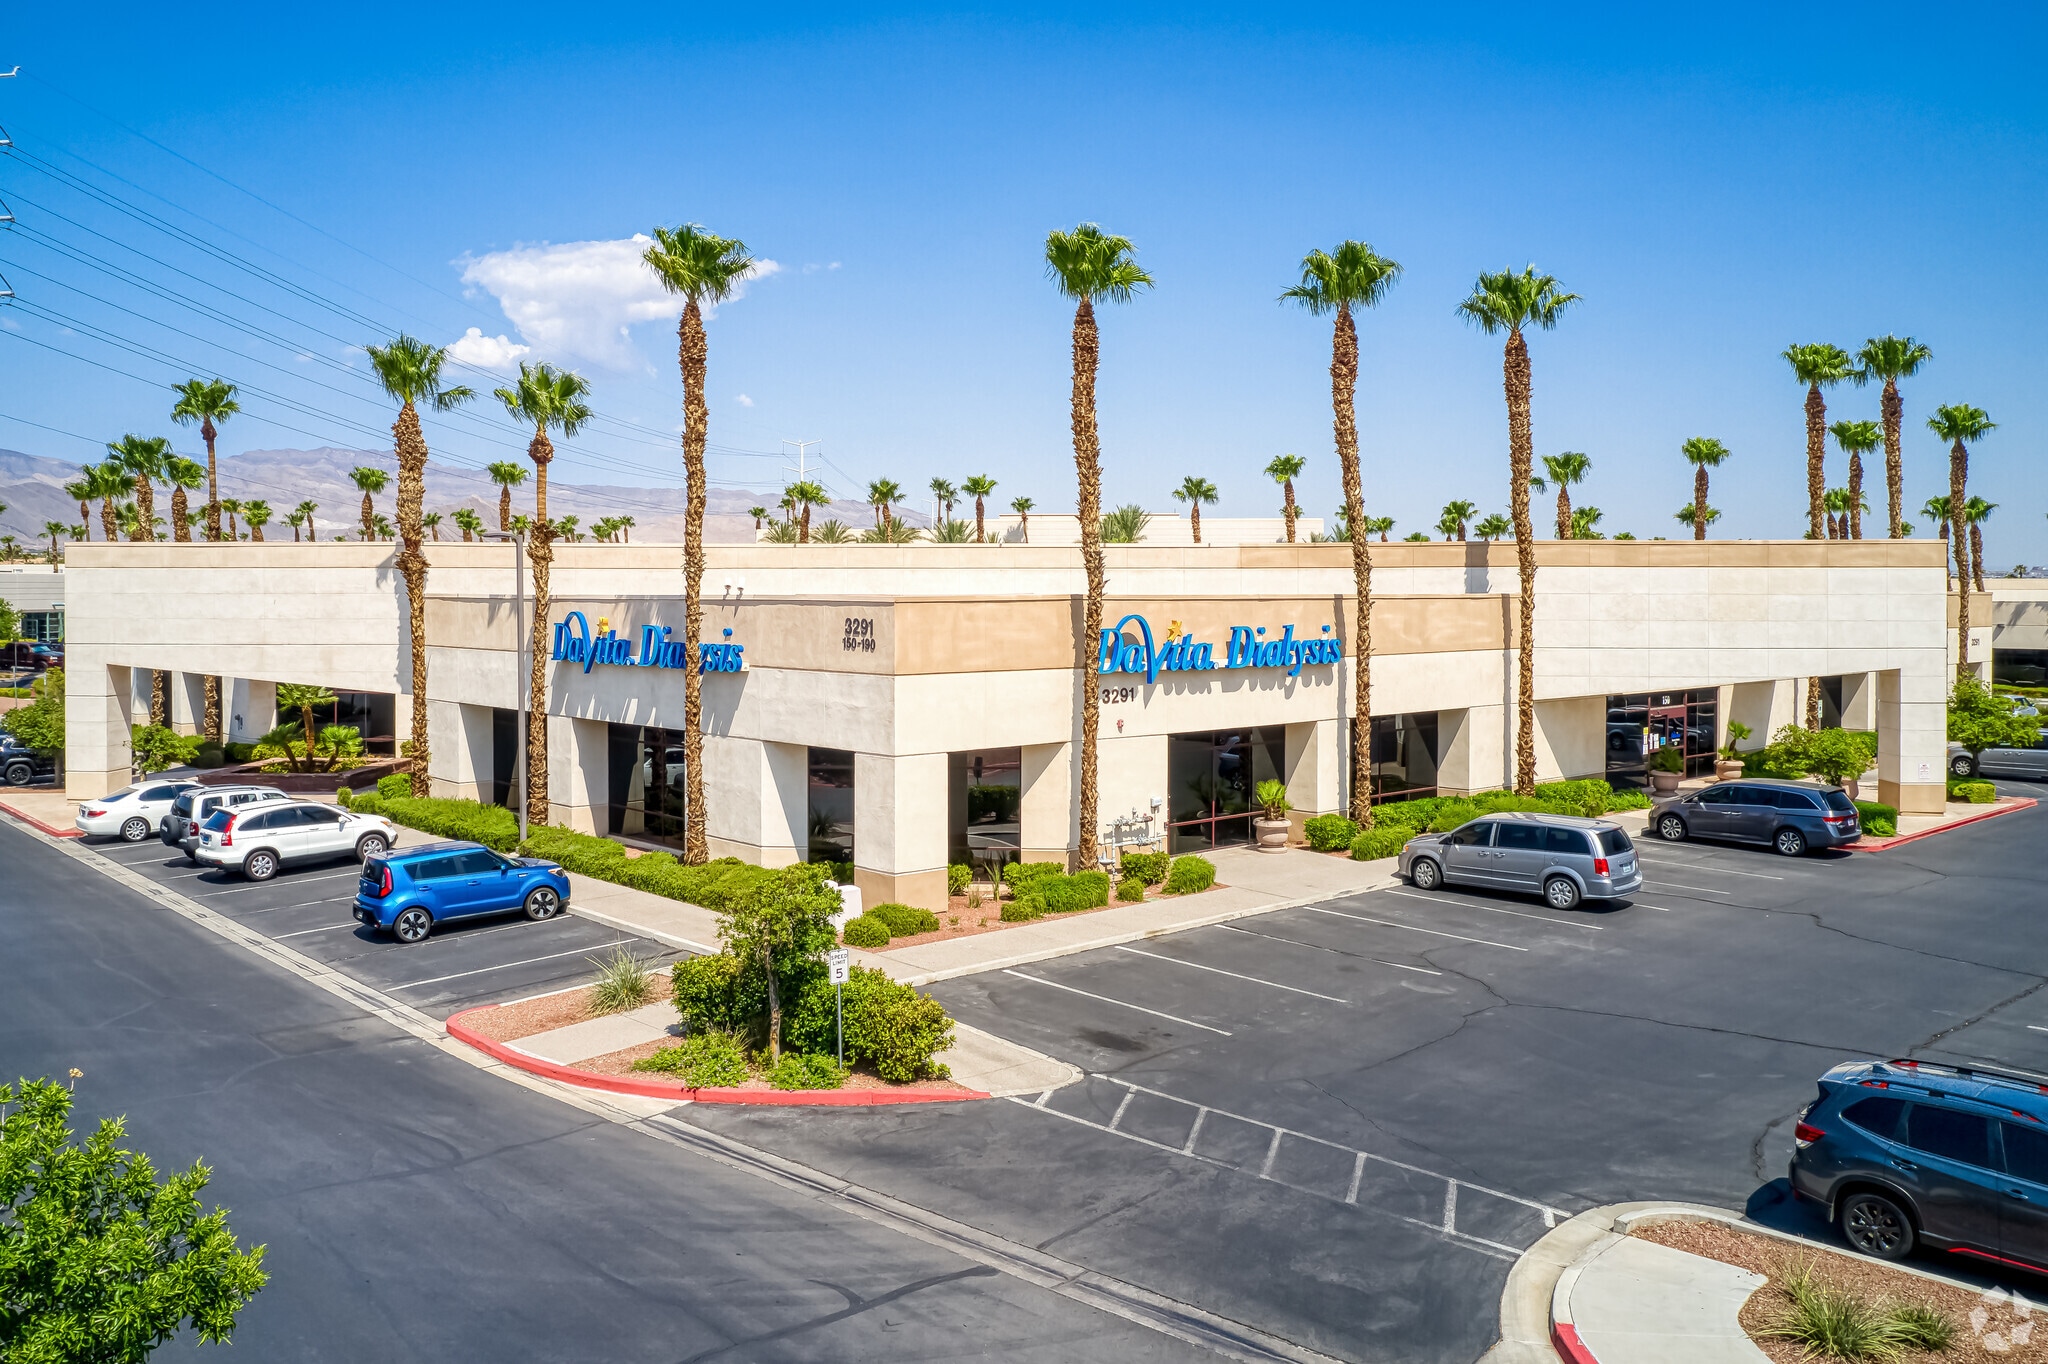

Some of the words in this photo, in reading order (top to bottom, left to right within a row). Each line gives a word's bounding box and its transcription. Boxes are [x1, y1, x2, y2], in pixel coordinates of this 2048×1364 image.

[845, 617, 873, 638] 3291
[639, 624, 744, 675] Diaysis
[842, 637, 877, 653] 150-190
[1225, 624, 1342, 677] Dialysis
[1102, 687, 1135, 704] 3291
[836, 968, 843, 979] 5
